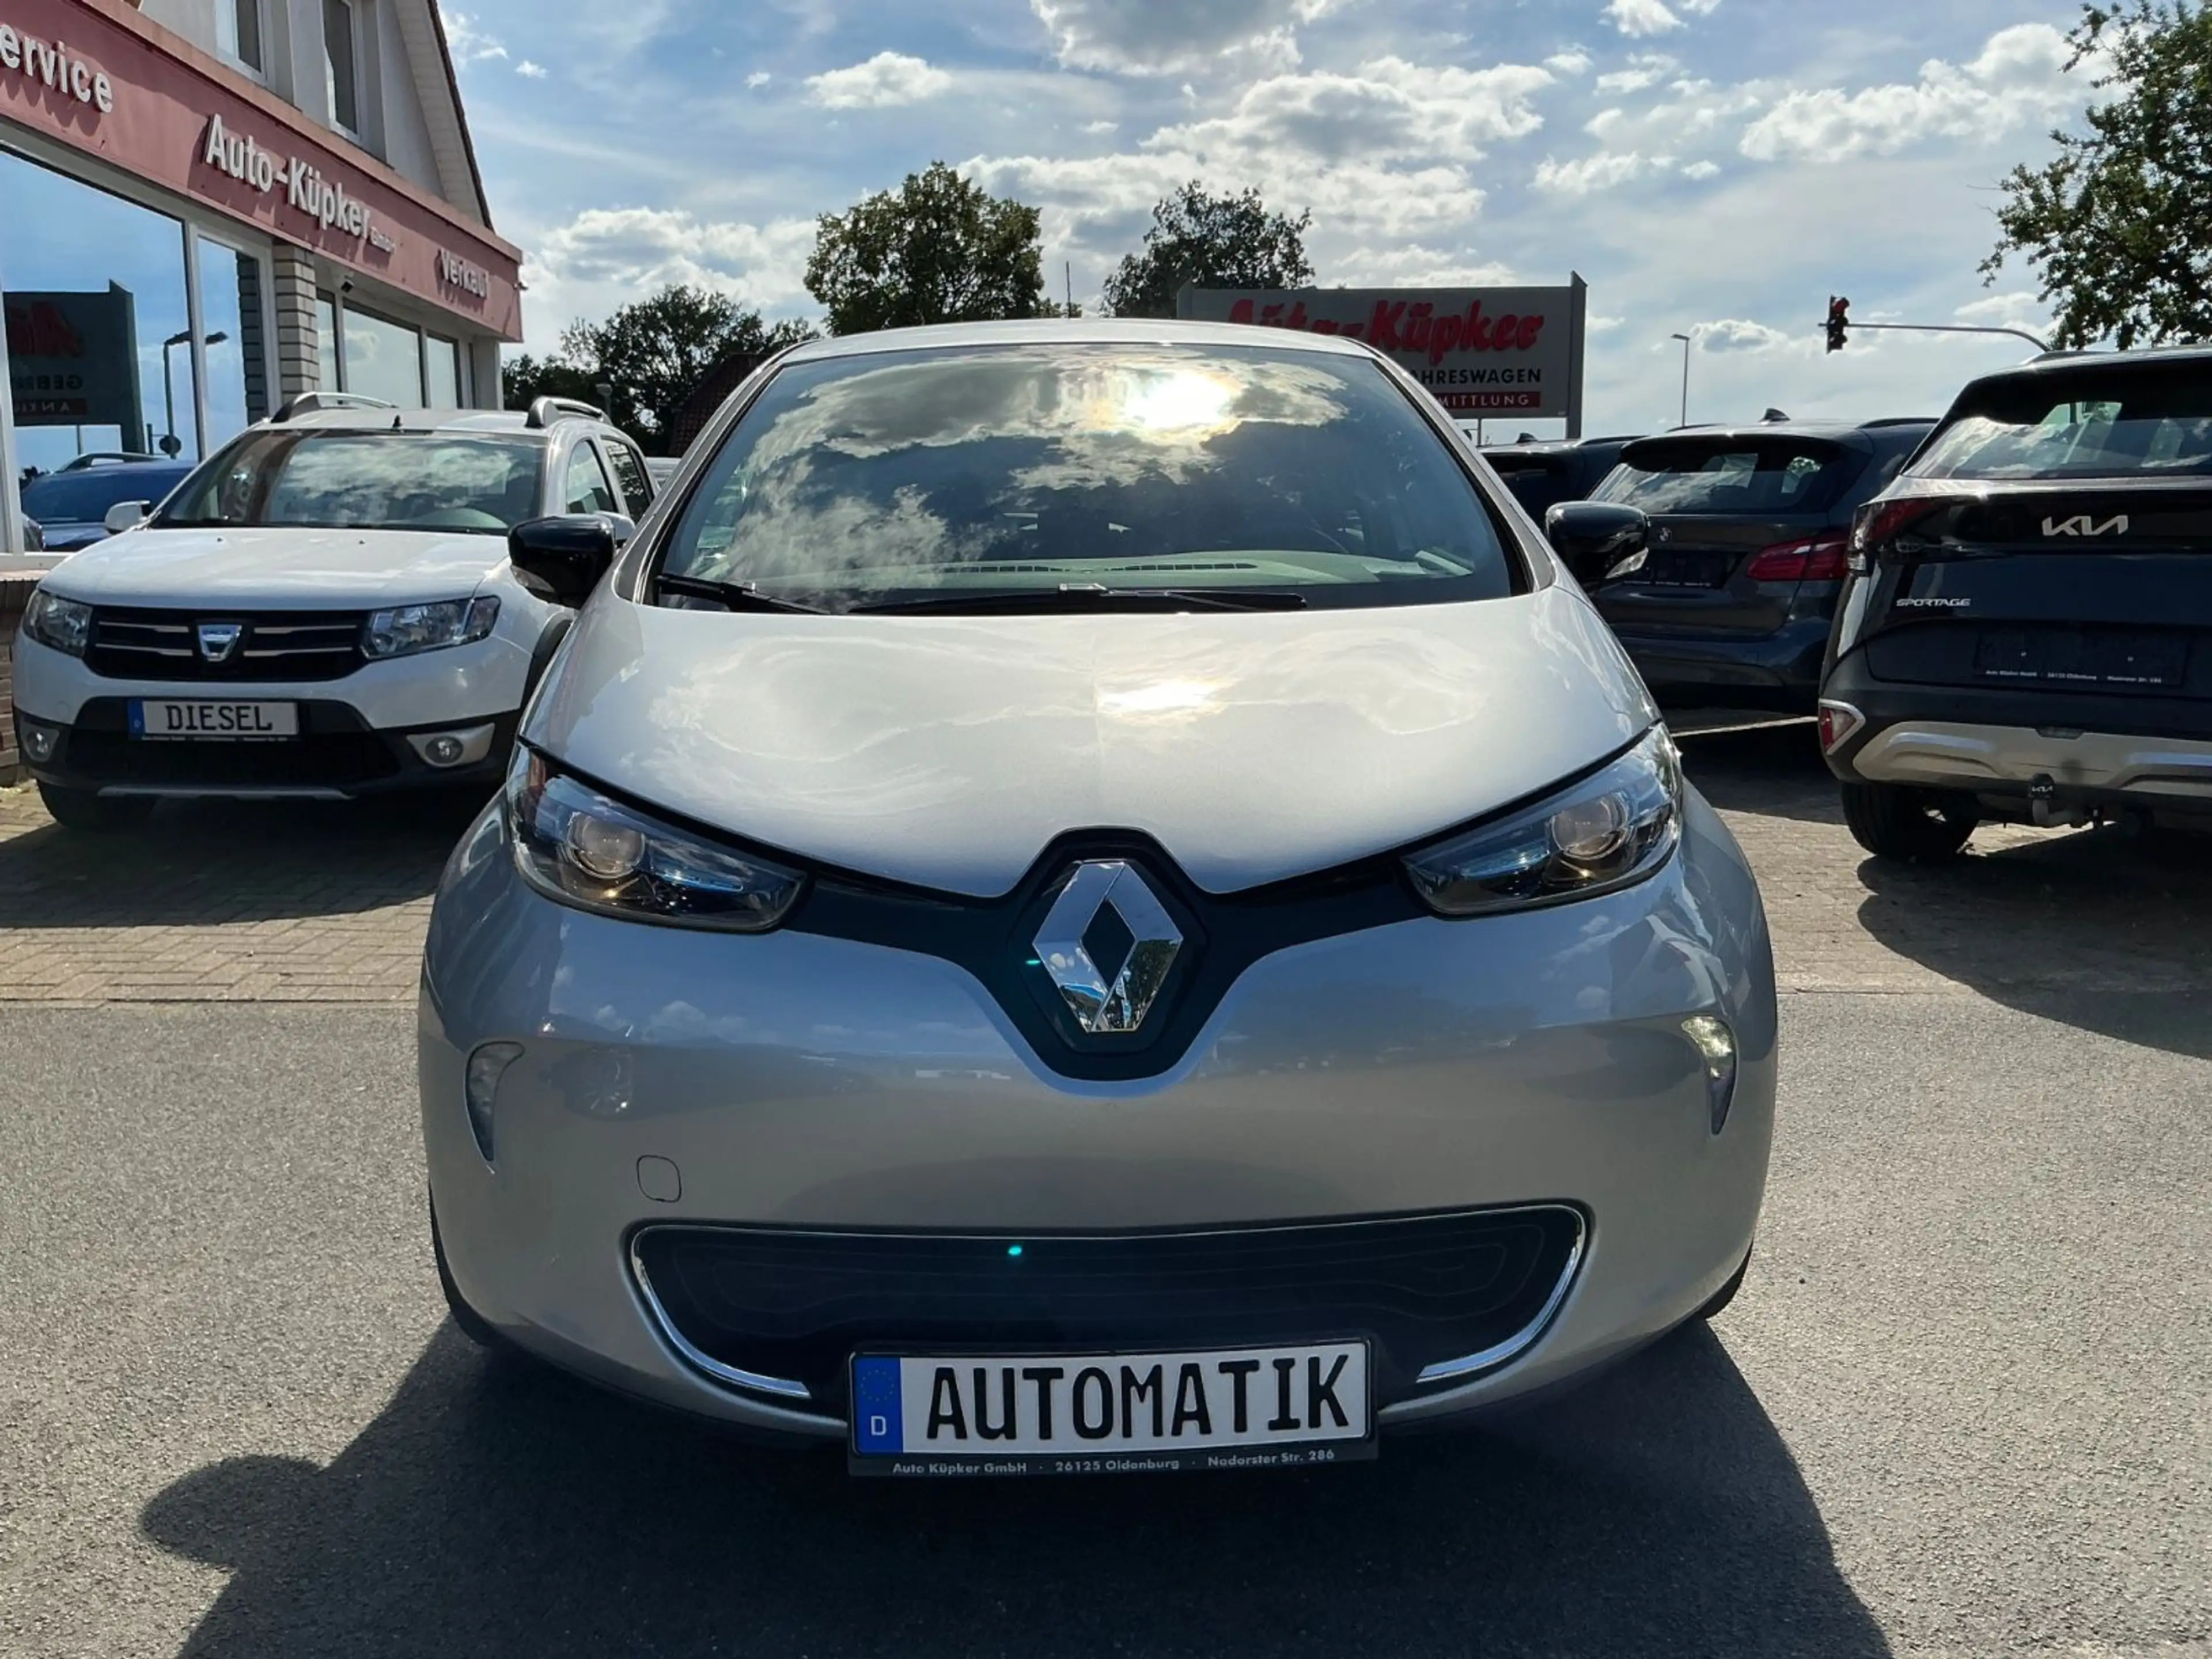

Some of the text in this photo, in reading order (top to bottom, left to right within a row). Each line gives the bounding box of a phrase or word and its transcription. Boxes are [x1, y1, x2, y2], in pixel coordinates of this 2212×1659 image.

[206, 113, 370, 239] Auto-Küpker
[2042, 515, 2128, 536] KIA
[1896, 599, 1971, 607] SPORTAGE
[166, 705, 273, 731] DIESEL
[926, 1354, 1350, 1440] AUTOMATIK
[870, 1415, 887, 1436] D
[893, 1463, 924, 1474] Auto
[929, 1463, 979, 1475] Küpker
[984, 1463, 1027, 1473] GmbH
[1055, 1461, 1100, 1472] 26125
[1105, 1459, 1180, 1470] Oldenburg
[1281, 1451, 1304, 1463] Str.
[1309, 1449, 1335, 1461] 286
